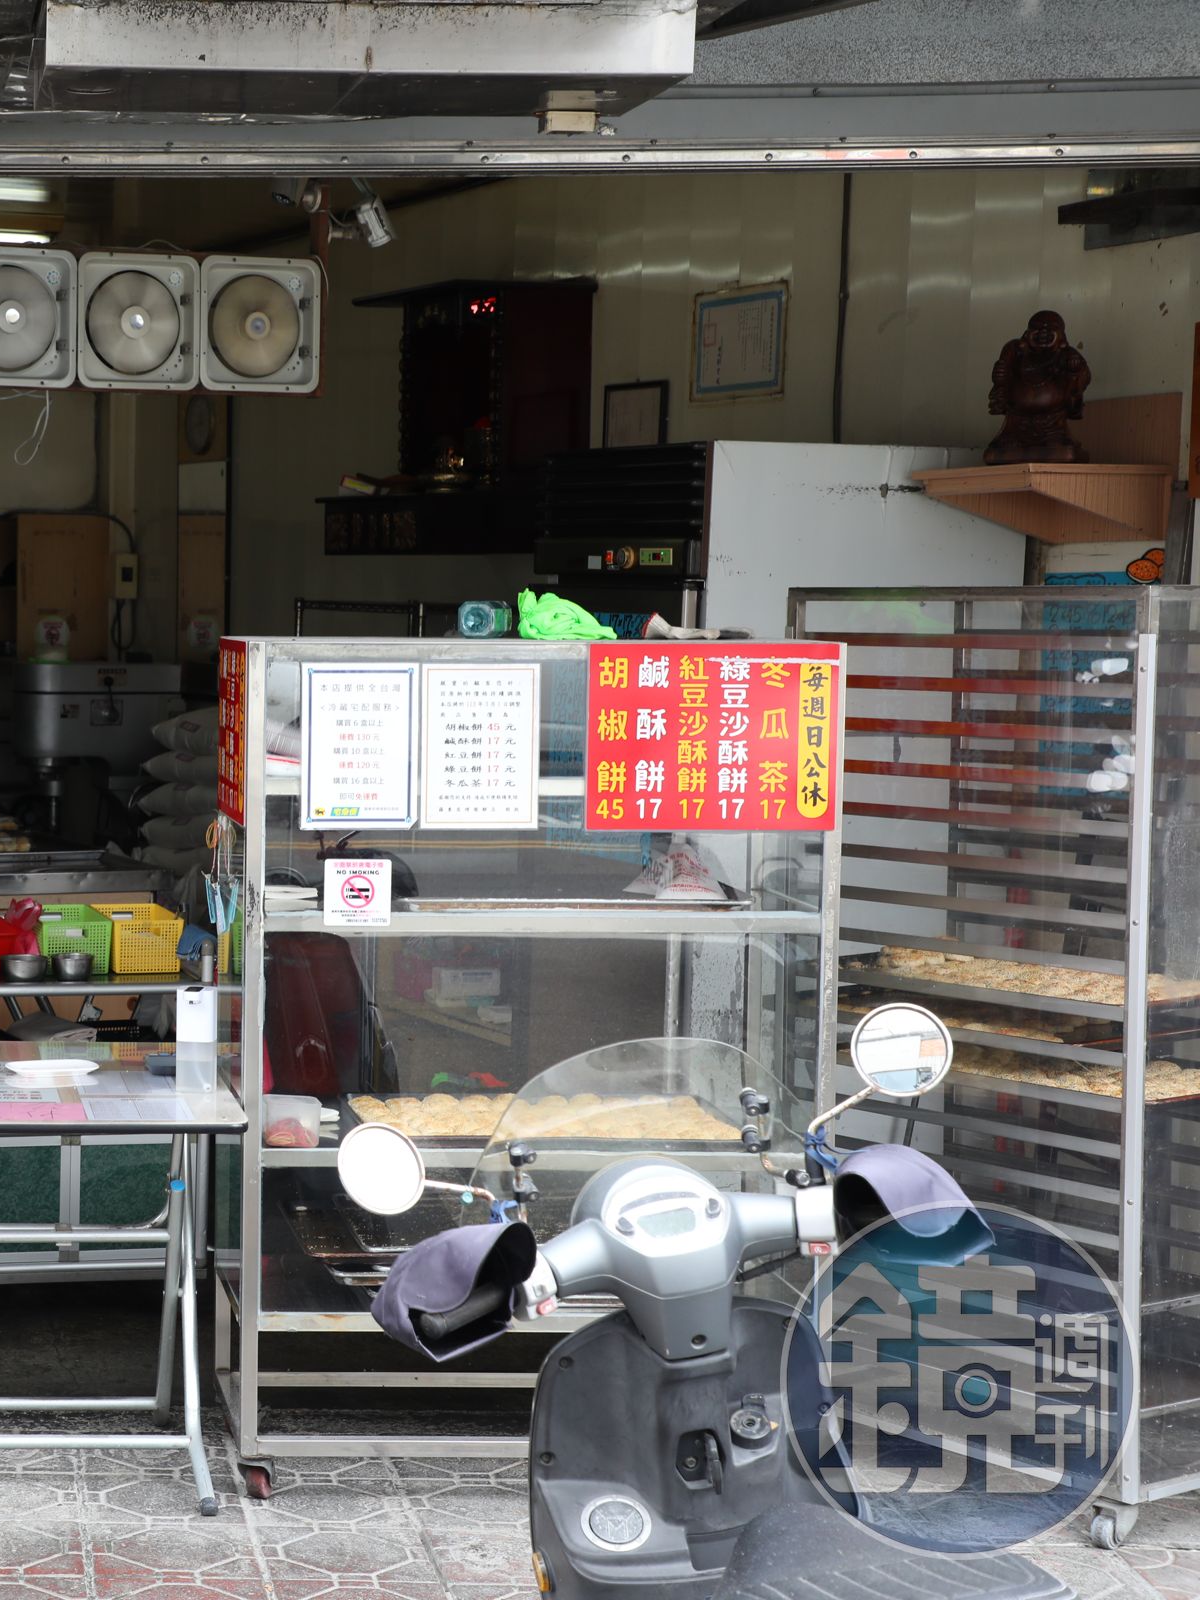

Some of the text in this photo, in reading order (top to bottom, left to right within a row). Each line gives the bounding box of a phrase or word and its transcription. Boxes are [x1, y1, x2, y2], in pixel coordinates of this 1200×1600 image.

[596, 656, 629, 793] 胡椒餅
[634, 655, 669, 793] 鹹酥餅
[677, 655, 709, 793] 紅豆沙酥餅
[717, 655, 750, 793] 綠豆沙酥餅
[758, 656, 791, 793] 冬瓜茶
[801, 663, 829, 807] 每週日公休
[596, 798, 625, 820] 45
[636, 798, 662, 820] 17
[679, 798, 705, 820] 17
[718, 798, 744, 820] 17
[760, 799, 786, 820] 17
